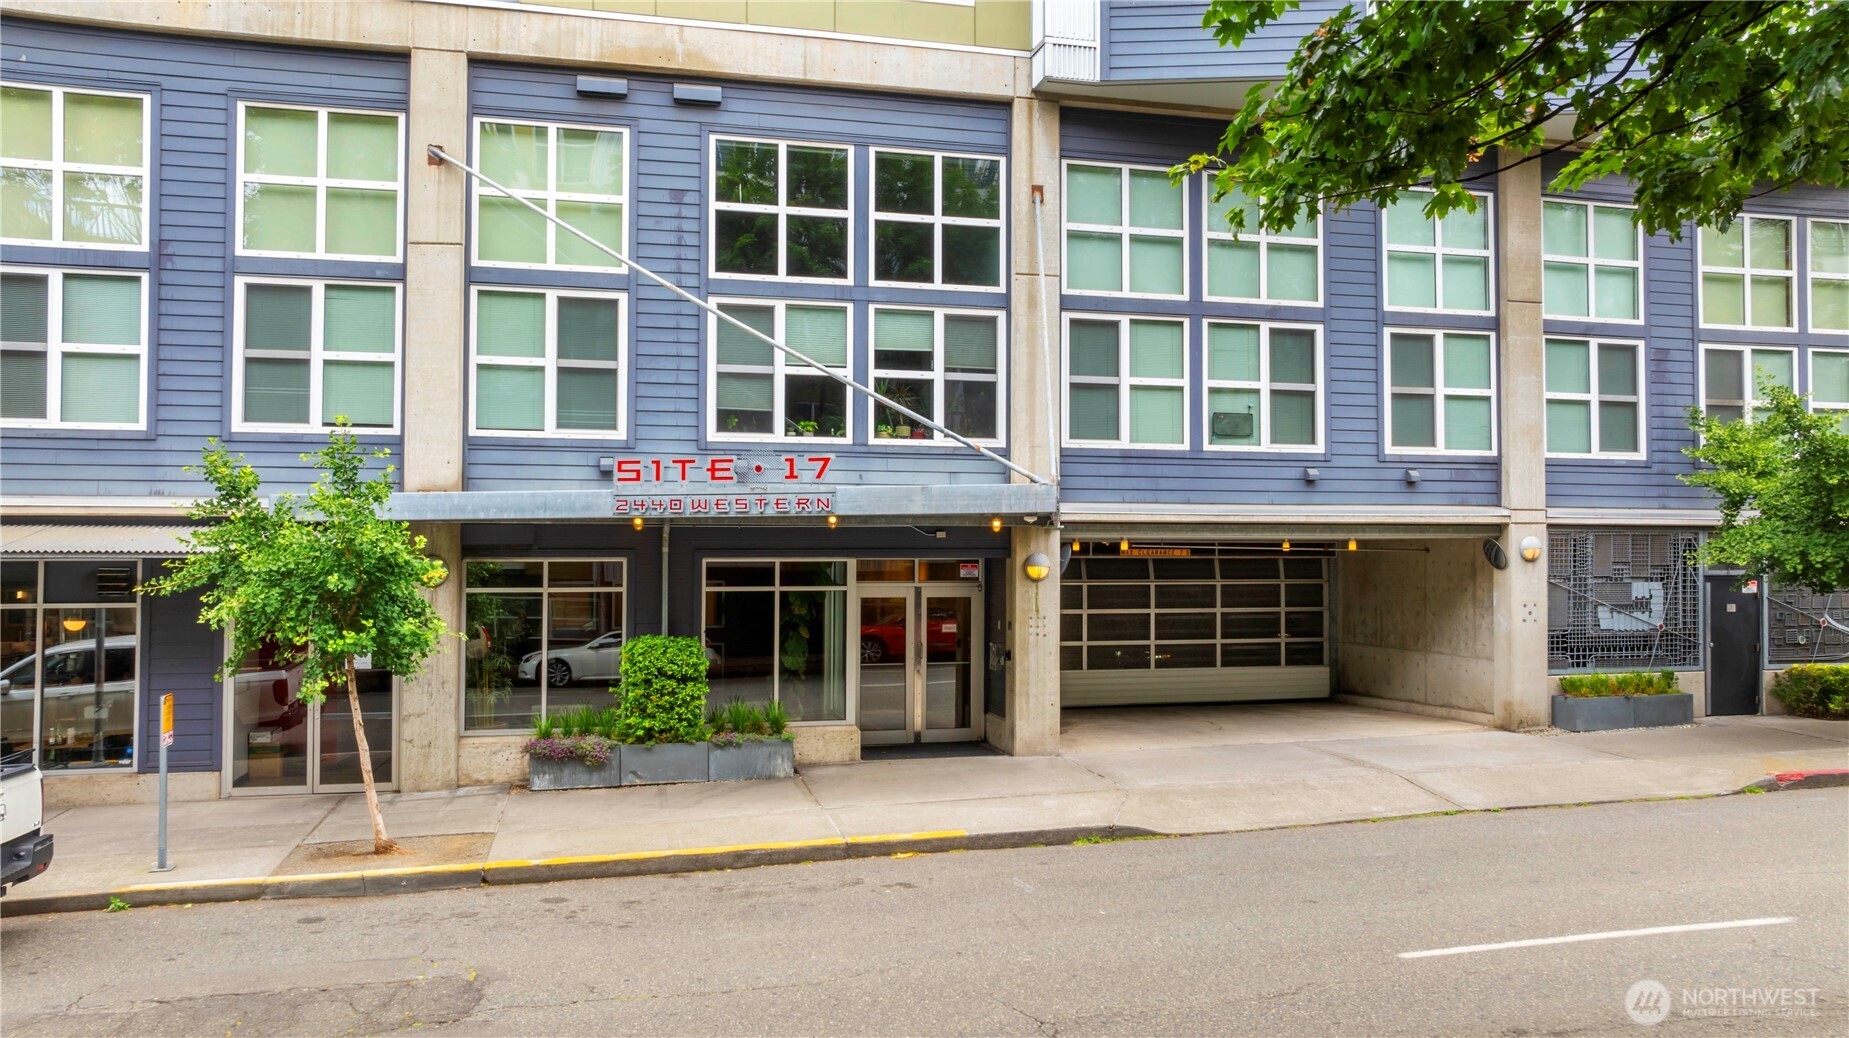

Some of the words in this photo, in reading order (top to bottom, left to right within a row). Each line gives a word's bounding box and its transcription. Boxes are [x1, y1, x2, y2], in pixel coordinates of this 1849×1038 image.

[615, 457, 735, 483] SITE
[783, 456, 832, 481] 17
[615, 498, 685, 514] 2440
[690, 497, 832, 512] WESTERN
